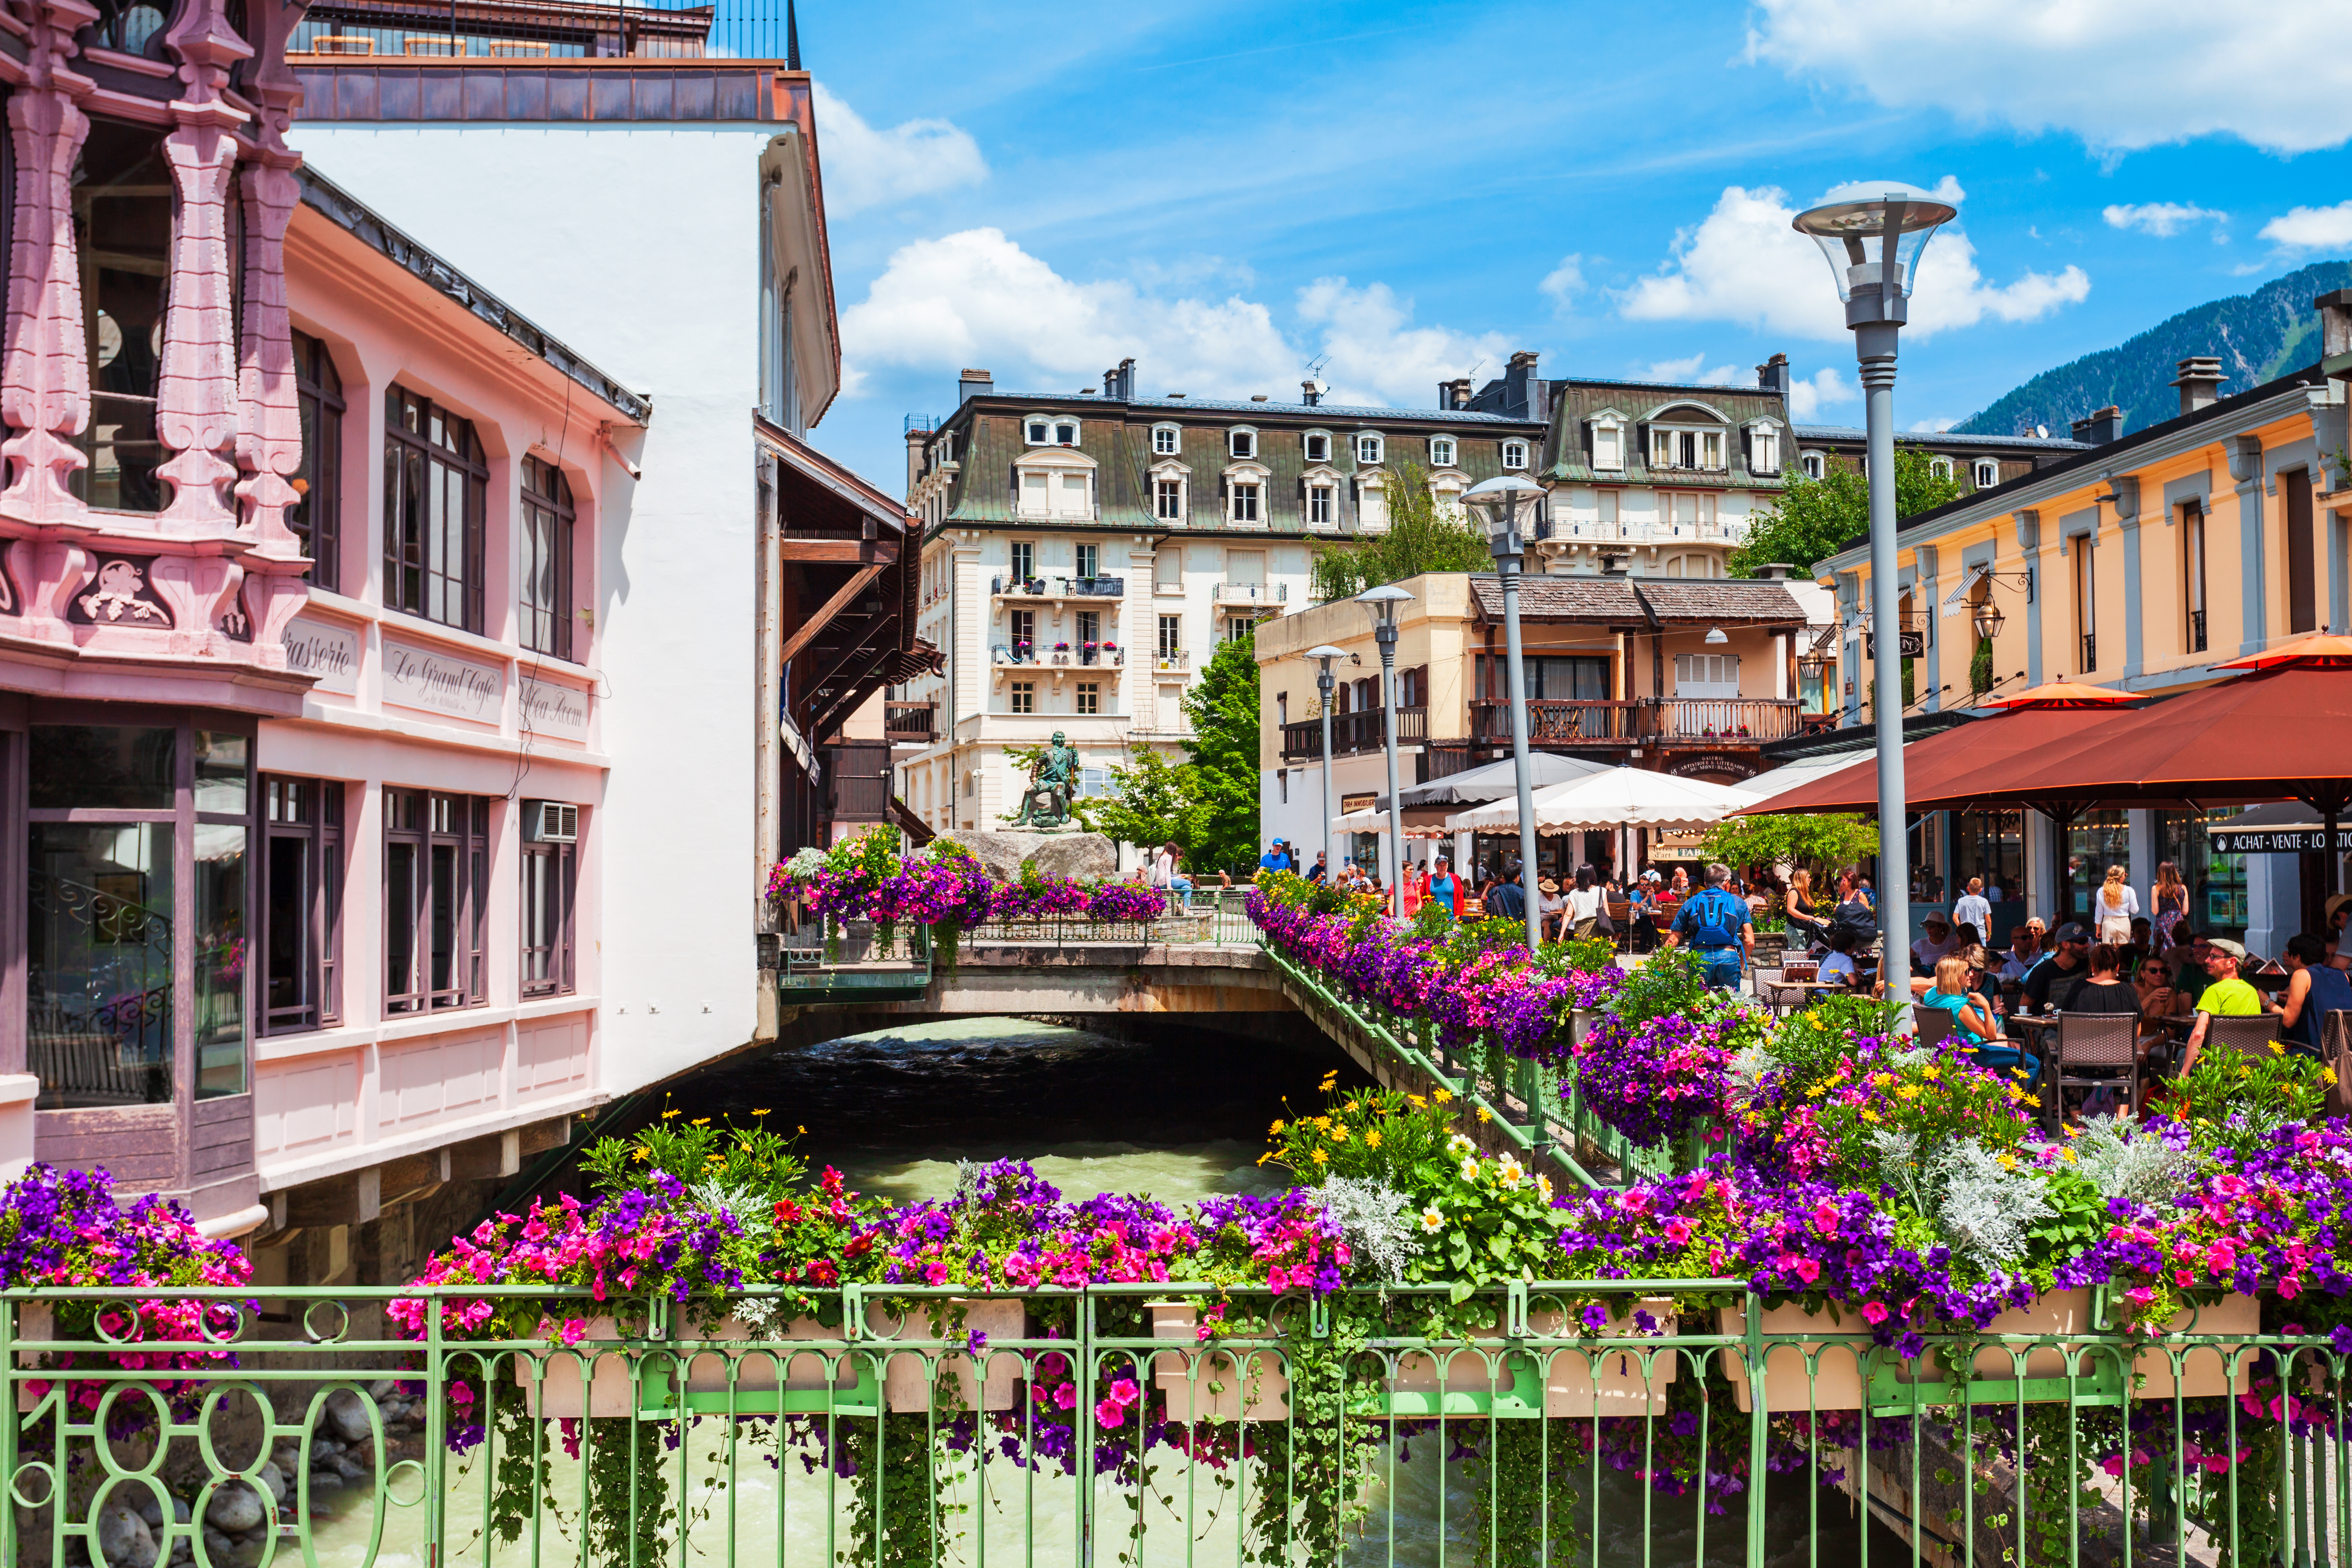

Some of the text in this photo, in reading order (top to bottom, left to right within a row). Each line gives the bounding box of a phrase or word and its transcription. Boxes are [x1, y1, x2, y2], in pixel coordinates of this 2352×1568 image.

[389, 650, 496, 715] Le Grand Café
[1681, 761, 1709, 771] ARTISTIQUE
[2233, 835, 2264, 849] ACHAT
[2272, 834, 2301, 849] VENTE
